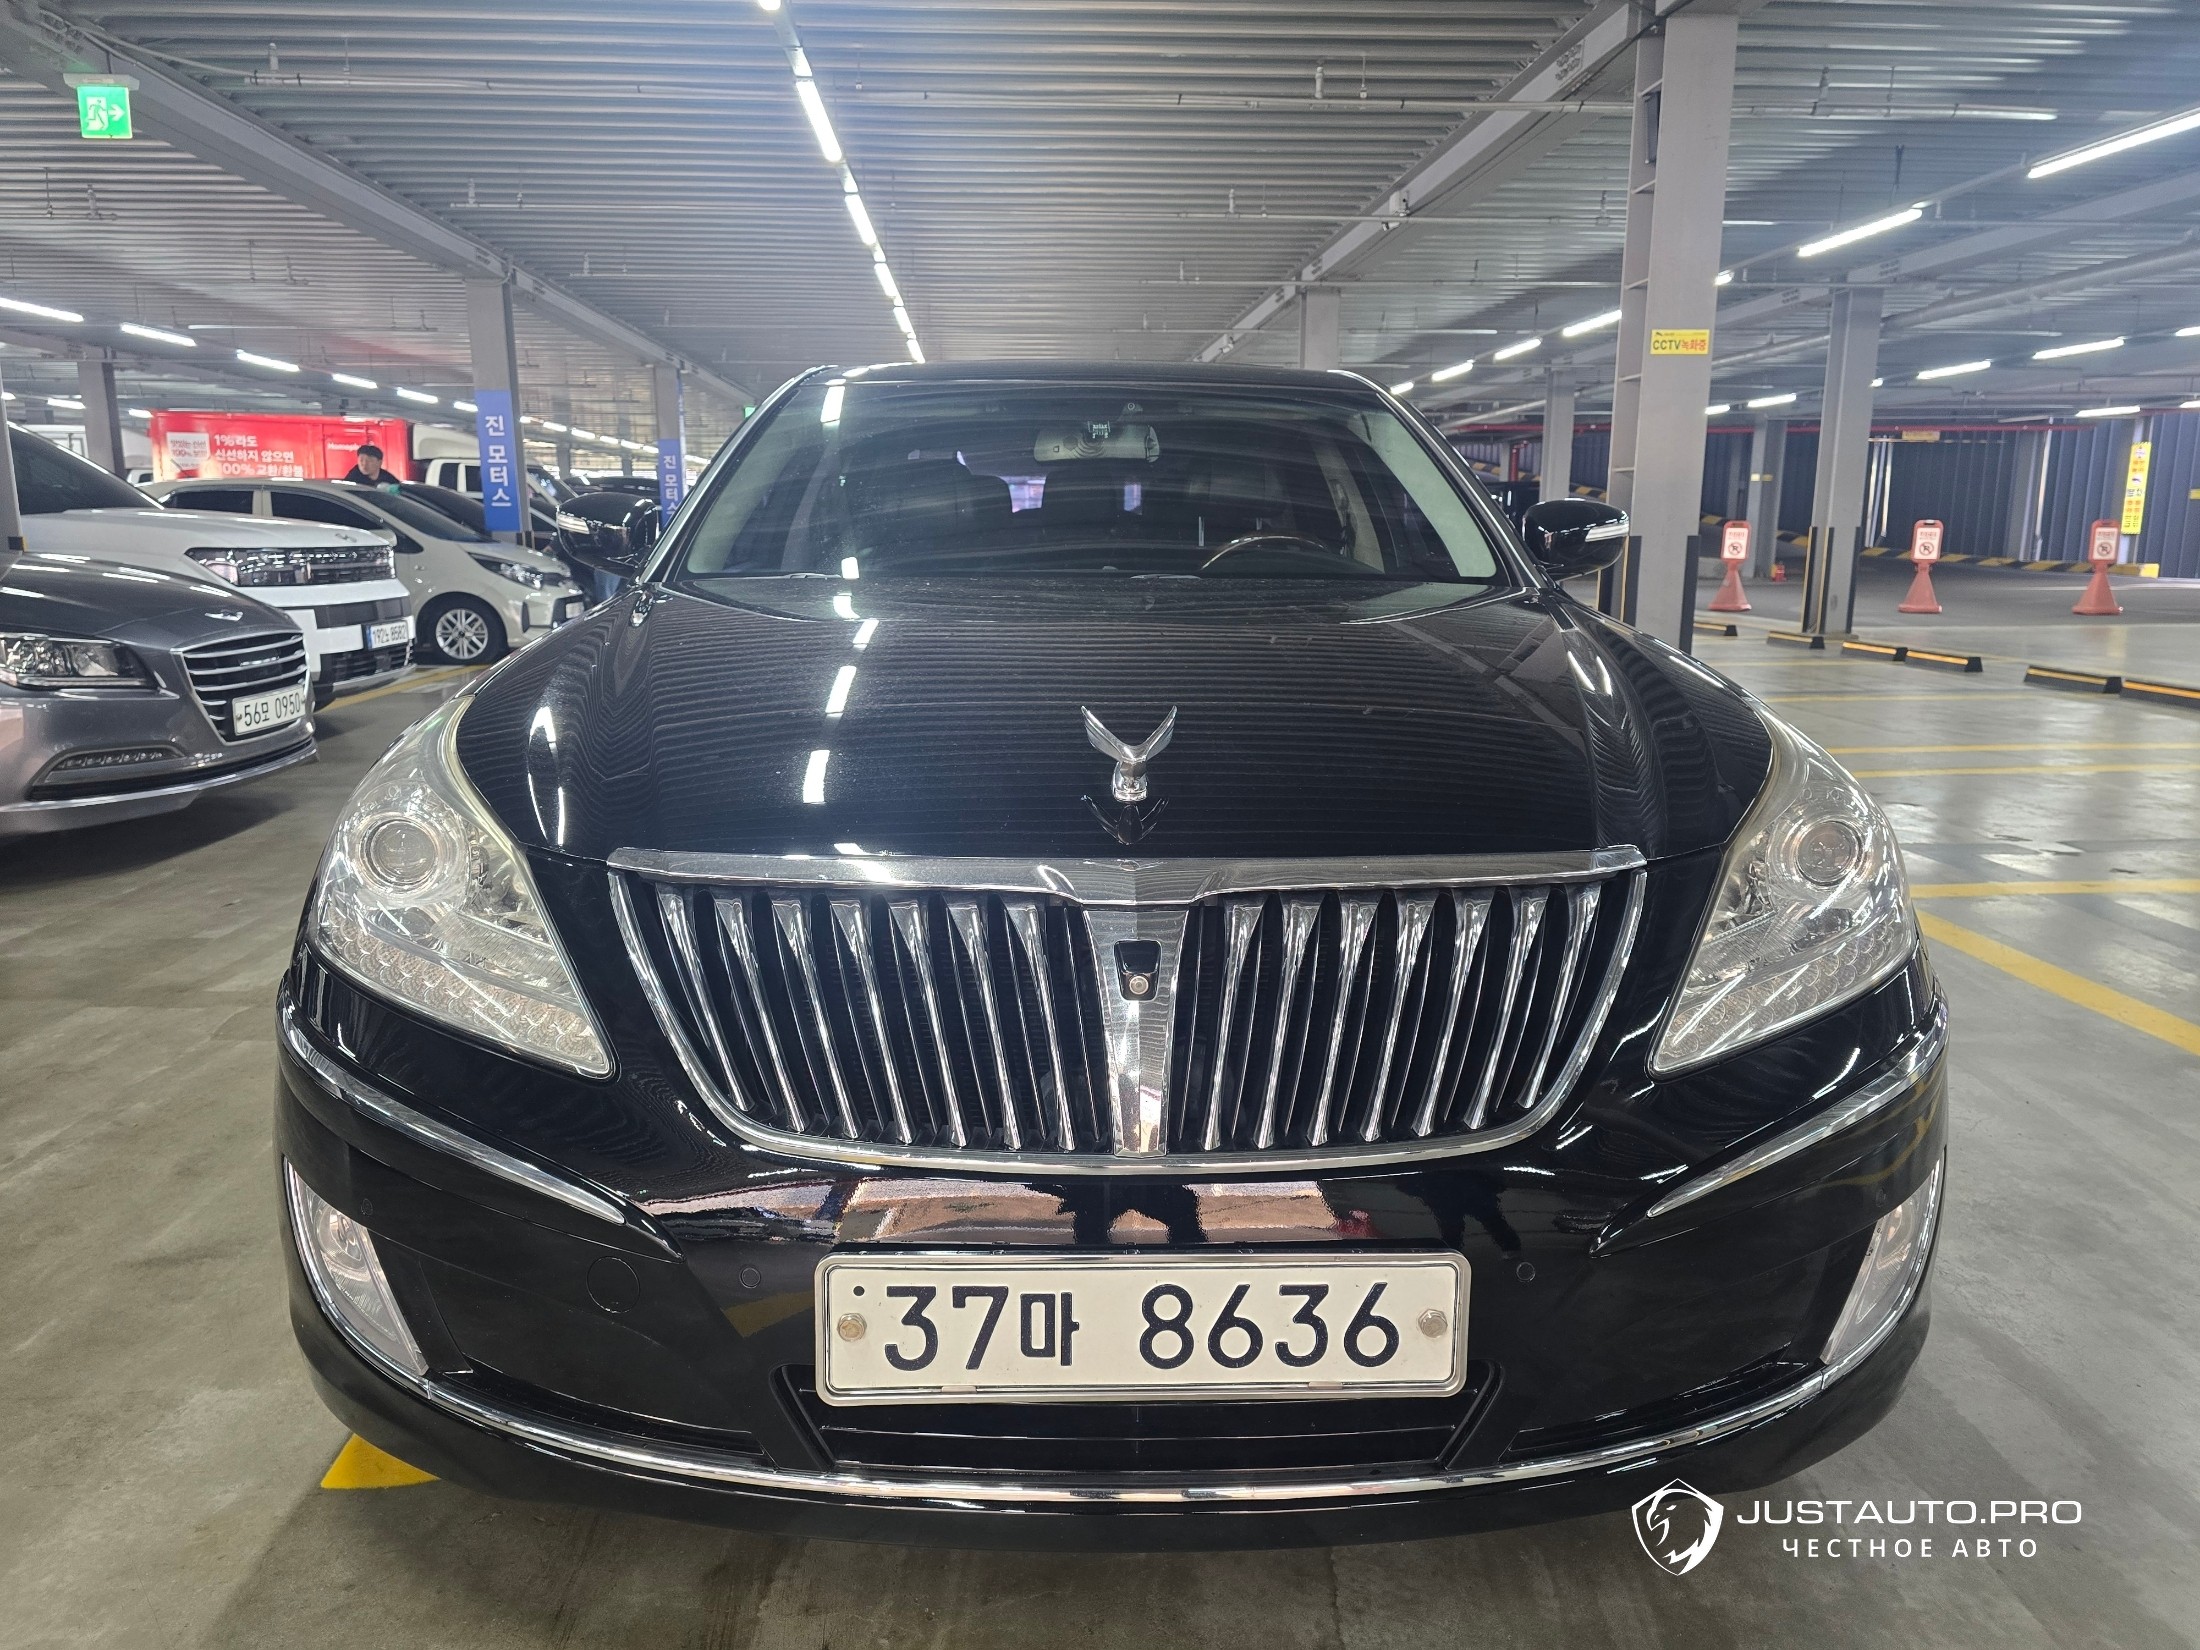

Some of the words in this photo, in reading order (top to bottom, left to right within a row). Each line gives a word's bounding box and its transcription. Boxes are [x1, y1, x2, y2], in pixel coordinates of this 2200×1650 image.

[485, 414, 505, 437] 진
[214, 433, 258, 448] 1%라도
[327, 441, 361, 452] Homeplu
[215, 448, 259, 462] 신선하지
[261, 450, 295, 464] 않으면
[663, 454, 677, 470] 진
[487, 444, 512, 508] 모터스
[664, 473, 680, 515] 모터스
[244, 702, 270, 727] 56모
[275, 692, 300, 719] 0950
[884, 1284, 1080, 1371] 37마
[1139, 1281, 1401, 1370] 8636
